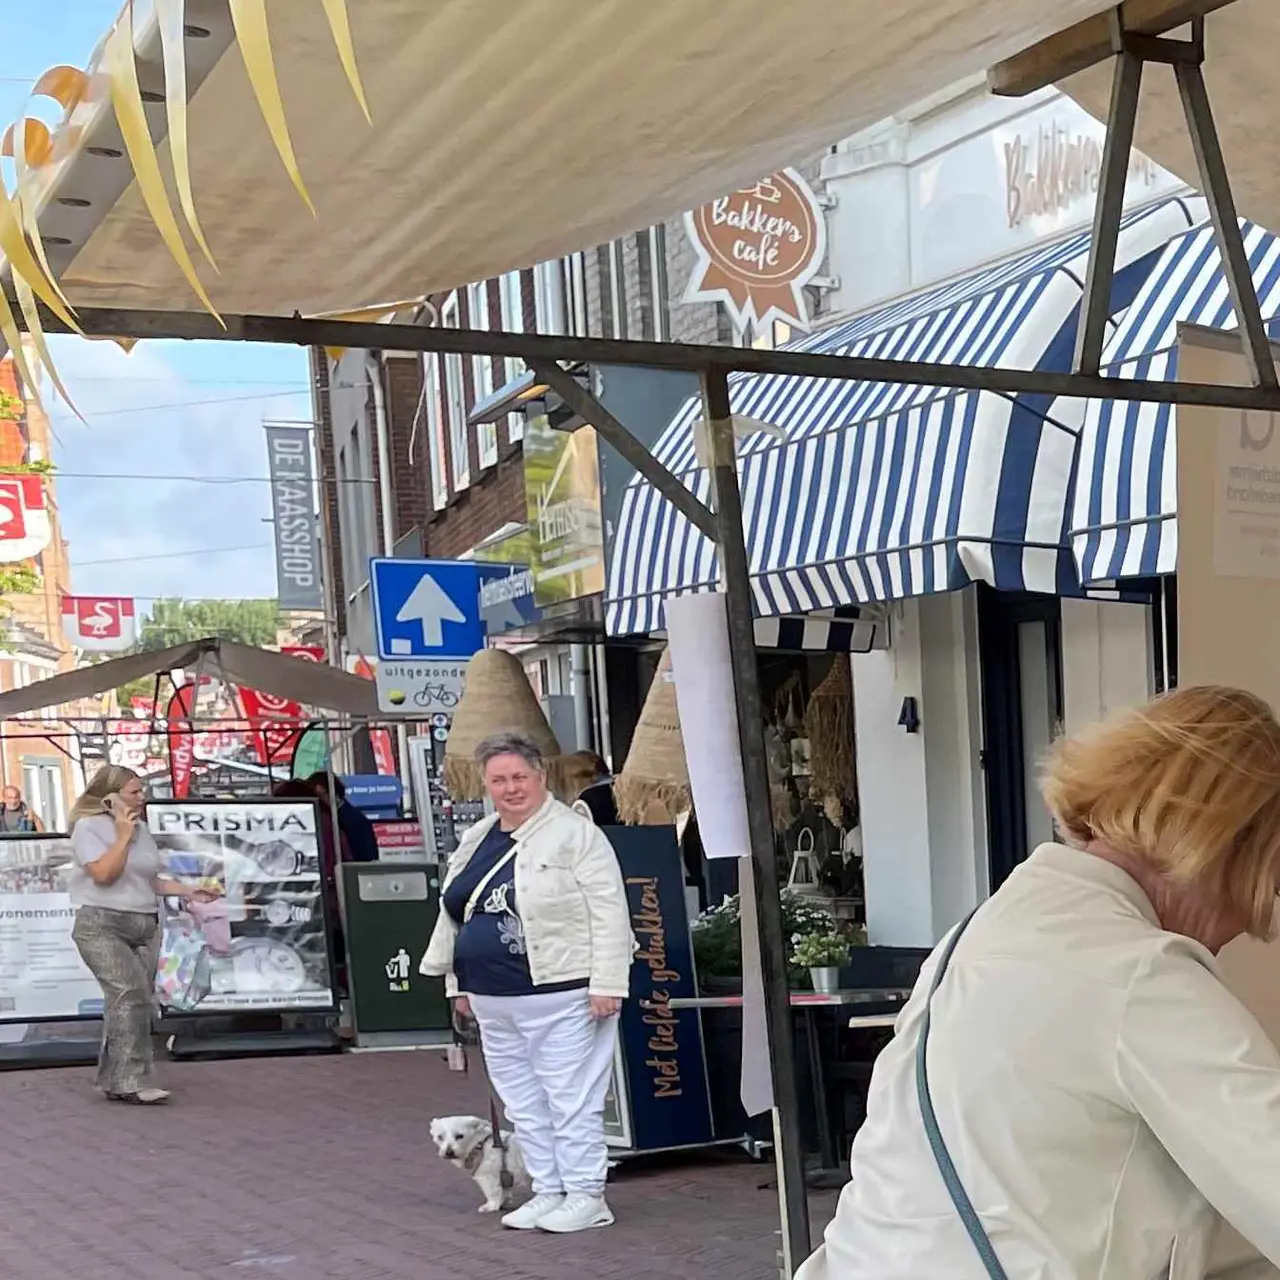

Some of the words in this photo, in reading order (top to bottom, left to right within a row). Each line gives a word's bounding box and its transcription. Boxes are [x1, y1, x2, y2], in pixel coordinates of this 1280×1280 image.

[712, 196, 802, 243] Bakkers
[733, 234, 779, 270] café
[272, 438, 304, 467] DE
[274, 471, 313, 587] KAASSHOP
[384, 667, 466, 679] uitgezonde
[899, 697, 918, 734] 4
[158, 812, 308, 833] PRISMA
[0, 907, 79, 919] venement
[625, 877, 682, 982] gebakken!
[640, 989, 681, 1051] liefde
[646, 1058, 683, 1098] Met
